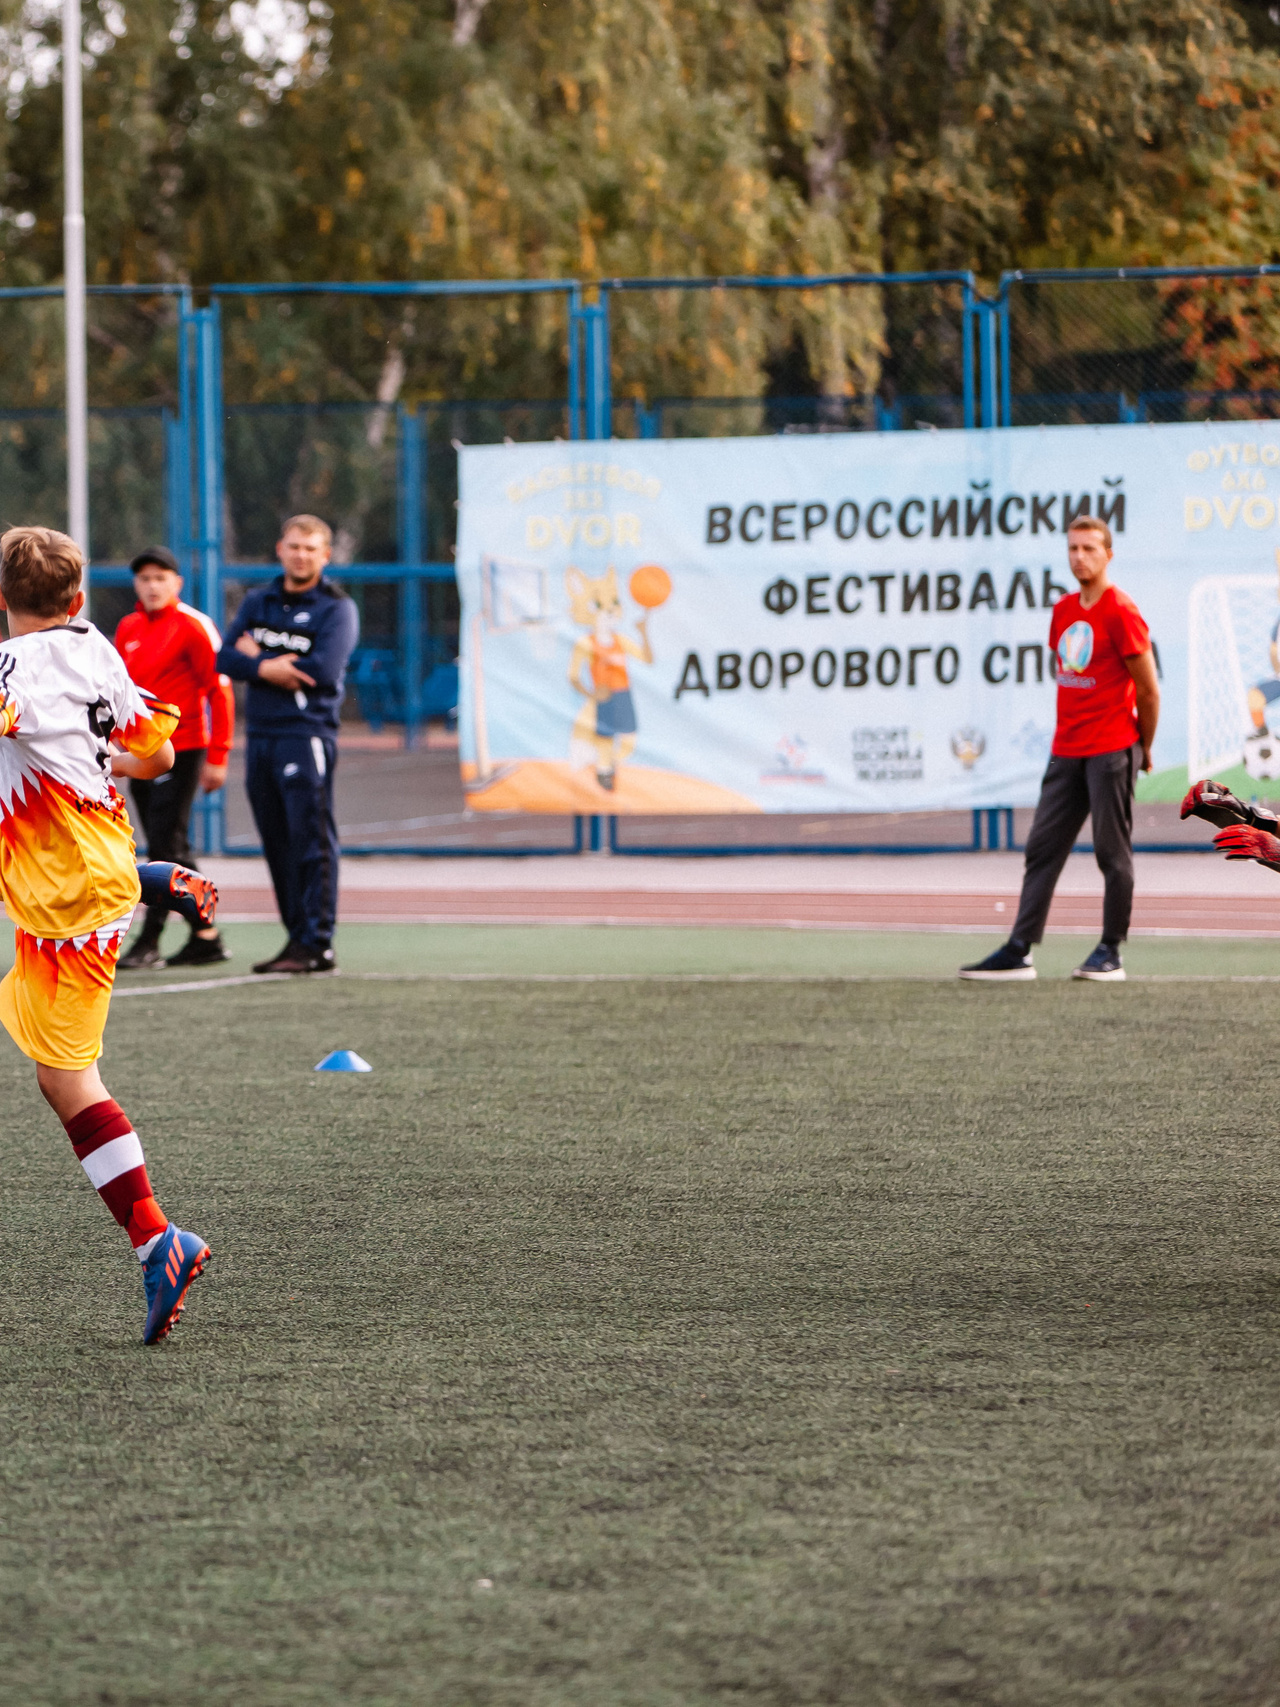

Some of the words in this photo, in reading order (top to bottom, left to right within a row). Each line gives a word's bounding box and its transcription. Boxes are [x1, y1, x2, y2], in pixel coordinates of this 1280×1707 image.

[527, 512, 642, 548] DVOR
[706, 478, 1126, 544] ВСЕРОССИЙСКИЙ
[1184, 495, 1280, 531] DVO
[763, 568, 1069, 615] ФЕСТИВАЛЬ
[675, 644, 960, 699] ДВОРОВОГО
